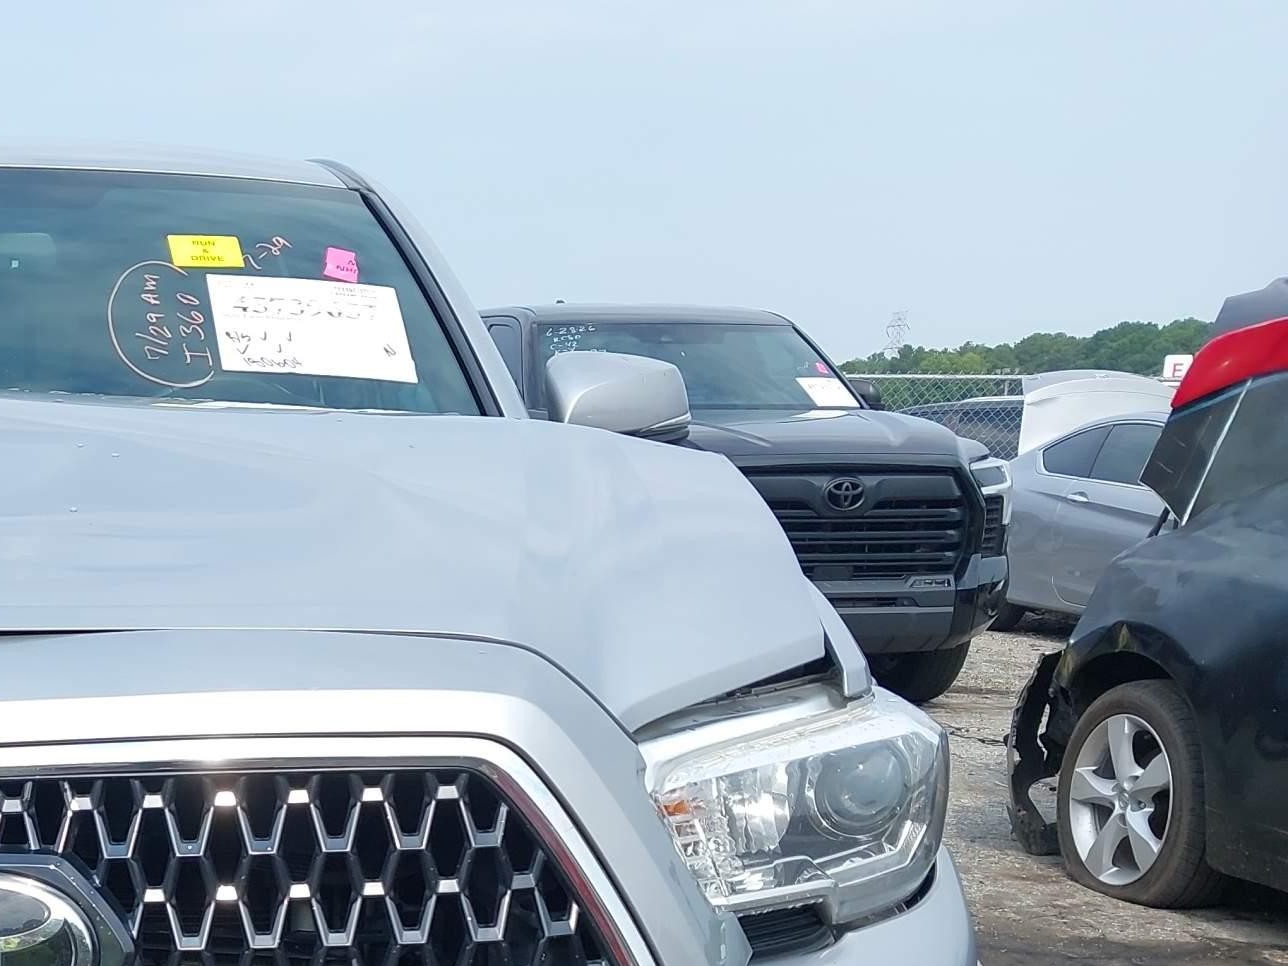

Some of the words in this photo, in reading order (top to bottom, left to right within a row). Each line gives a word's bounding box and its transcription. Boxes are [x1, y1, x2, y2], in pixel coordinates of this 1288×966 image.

[140, 274, 161, 305] AM
[136, 312, 173, 360] 7/29
[1172, 363, 1184, 378] E
